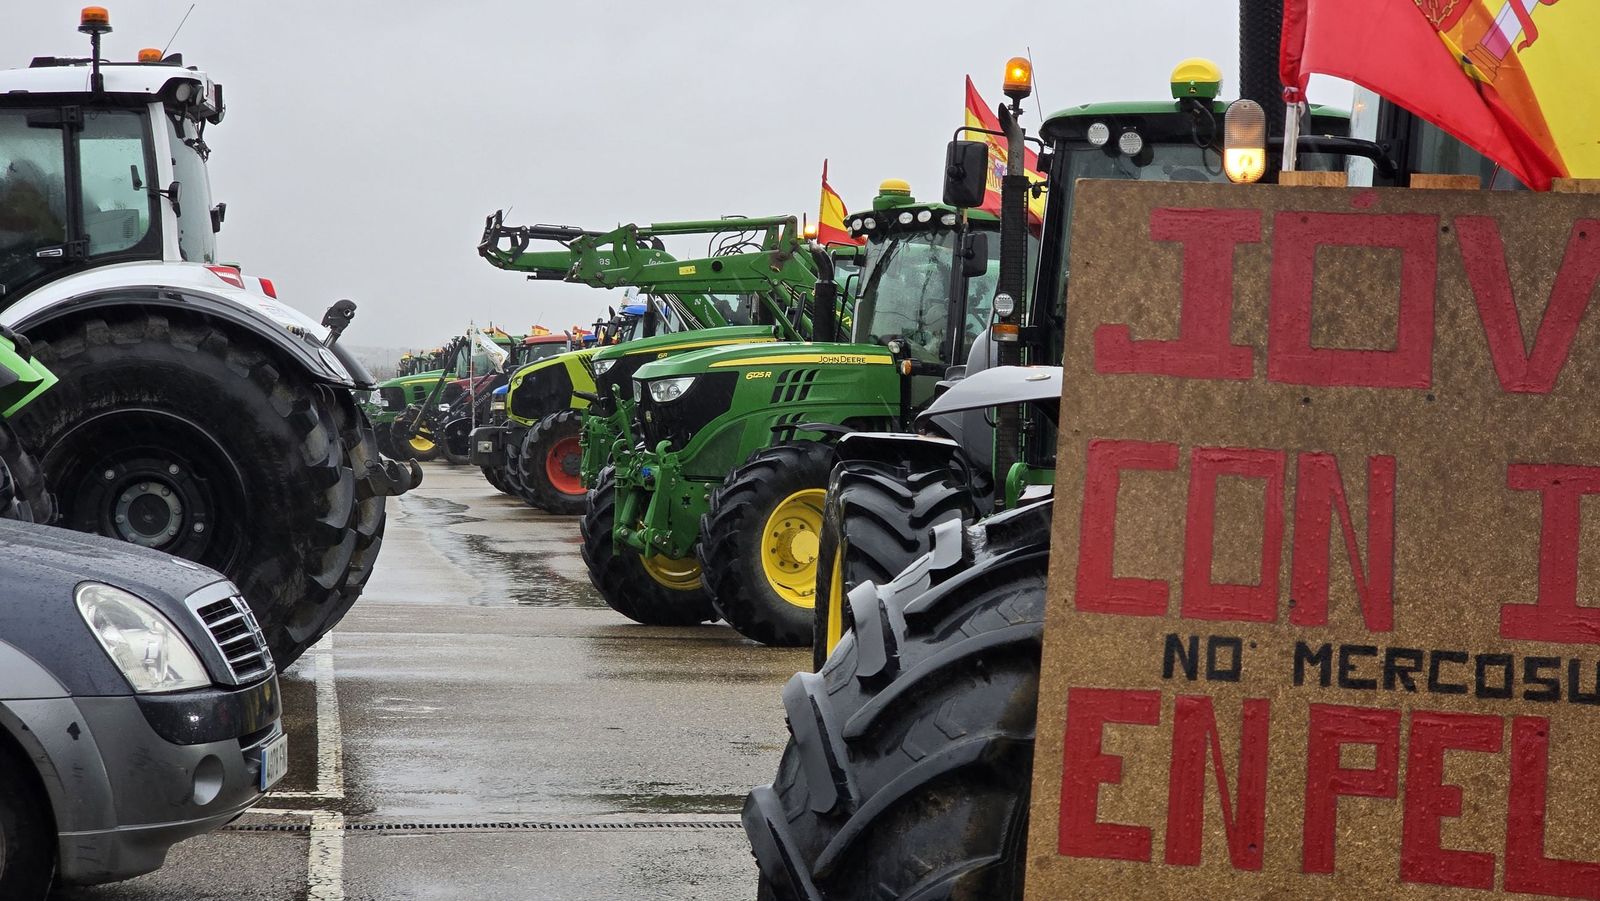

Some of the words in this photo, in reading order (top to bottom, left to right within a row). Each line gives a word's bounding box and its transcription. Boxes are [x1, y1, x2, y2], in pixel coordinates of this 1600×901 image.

[818, 355, 840, 363] JOHN
[840, 355, 867, 364] DEERE
[1075, 439, 1395, 633] CON
[1162, 633, 1242, 682] NO
[1293, 641, 1600, 706] MERCOSU
[1058, 688, 1269, 870] EN
[1304, 704, 1600, 900] PEL
